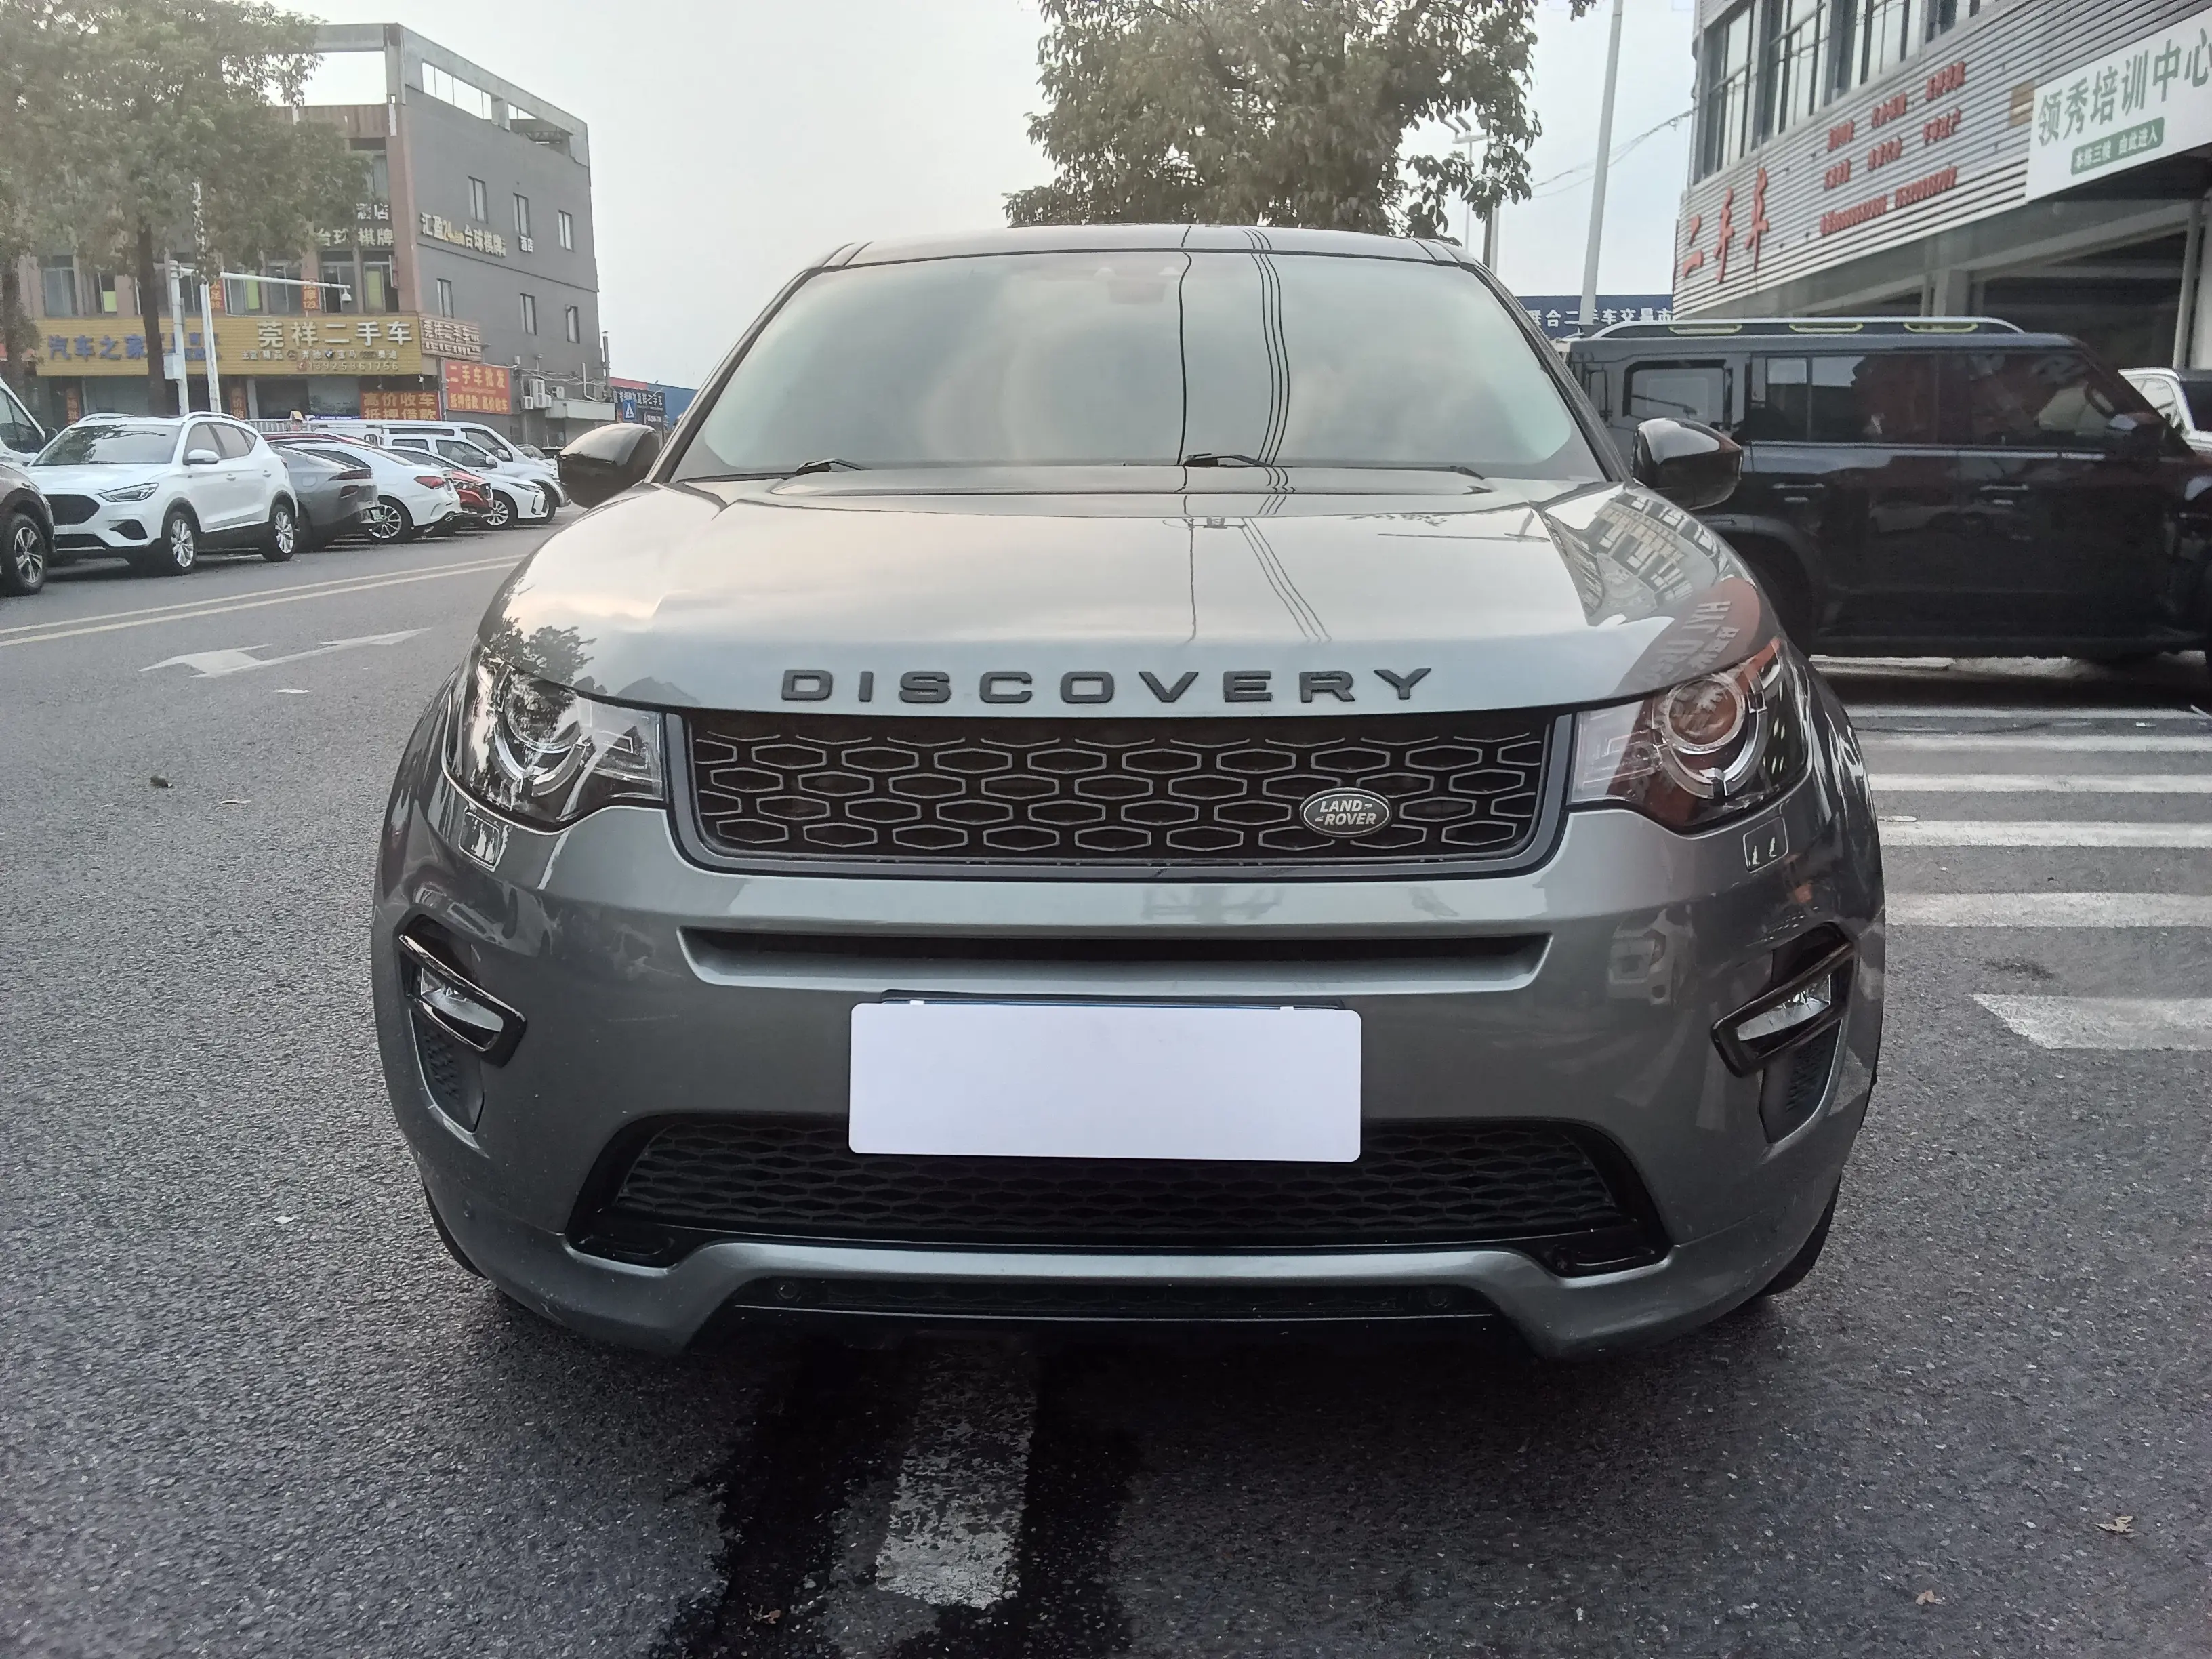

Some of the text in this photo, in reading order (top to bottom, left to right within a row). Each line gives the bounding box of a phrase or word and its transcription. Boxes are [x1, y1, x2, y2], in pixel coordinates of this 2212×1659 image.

[2038, 27, 2212, 146] 领秀培训中心
[257, 321, 413, 348] 莞祥二手车
[450, 365, 506, 388] 二手车批发
[363, 392, 436, 407] 高价收车
[364, 408, 436, 420] 抵押借款
[781, 668, 1431, 704] DISCOVERY
[1320, 800, 1363, 813] LAND
[1324, 813, 1376, 825] ROVER
